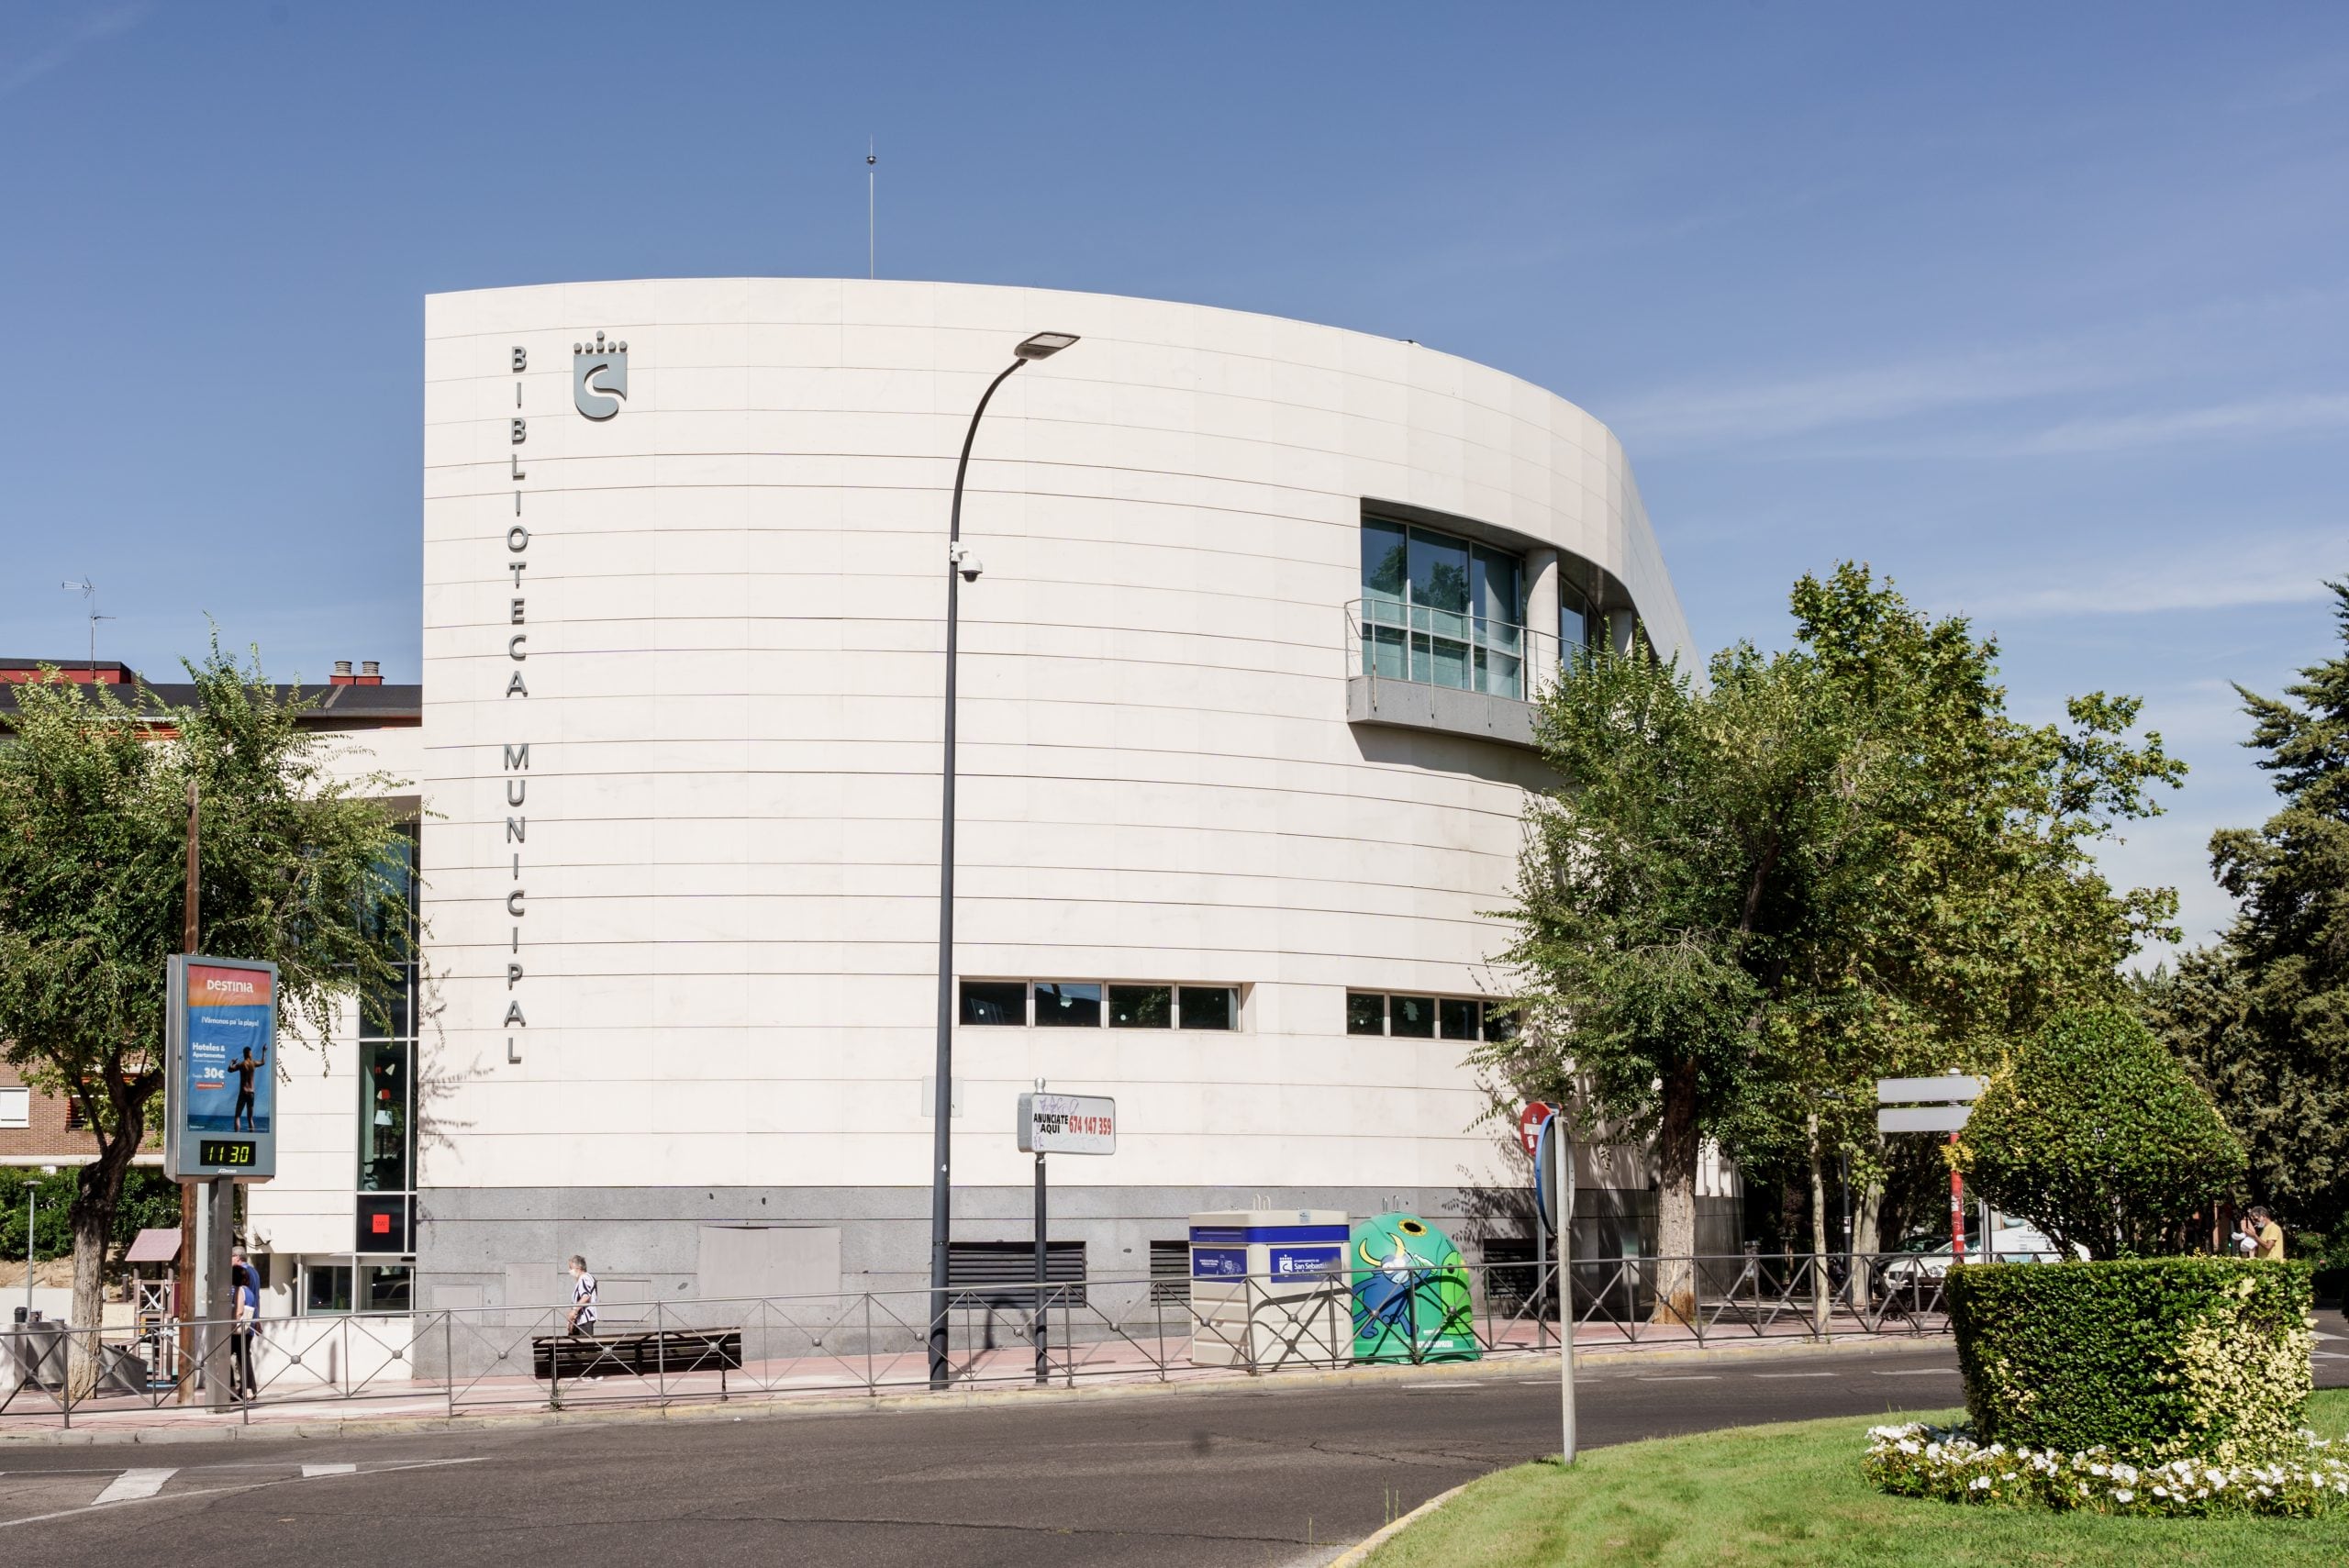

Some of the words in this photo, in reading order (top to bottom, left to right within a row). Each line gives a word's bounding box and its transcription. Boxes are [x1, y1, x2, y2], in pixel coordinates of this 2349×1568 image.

[506, 346, 529, 698] BIBLIOTECA
[504, 742, 529, 1065] MUNICIPAL
[192, 1041, 220, 1052] Hoteles
[220, 1044, 226, 1052] &
[204, 1067, 226, 1080] 30€
[1033, 1113, 1069, 1125] ANUNCIATE
[1068, 1115, 1083, 1135] 674
[1084, 1116, 1097, 1136] 147
[1098, 1117, 1112, 1136] 359
[208, 1146, 224, 1162] 11
[228, 1146, 250, 1163] 30
[1294, 1262, 1305, 1271] San
